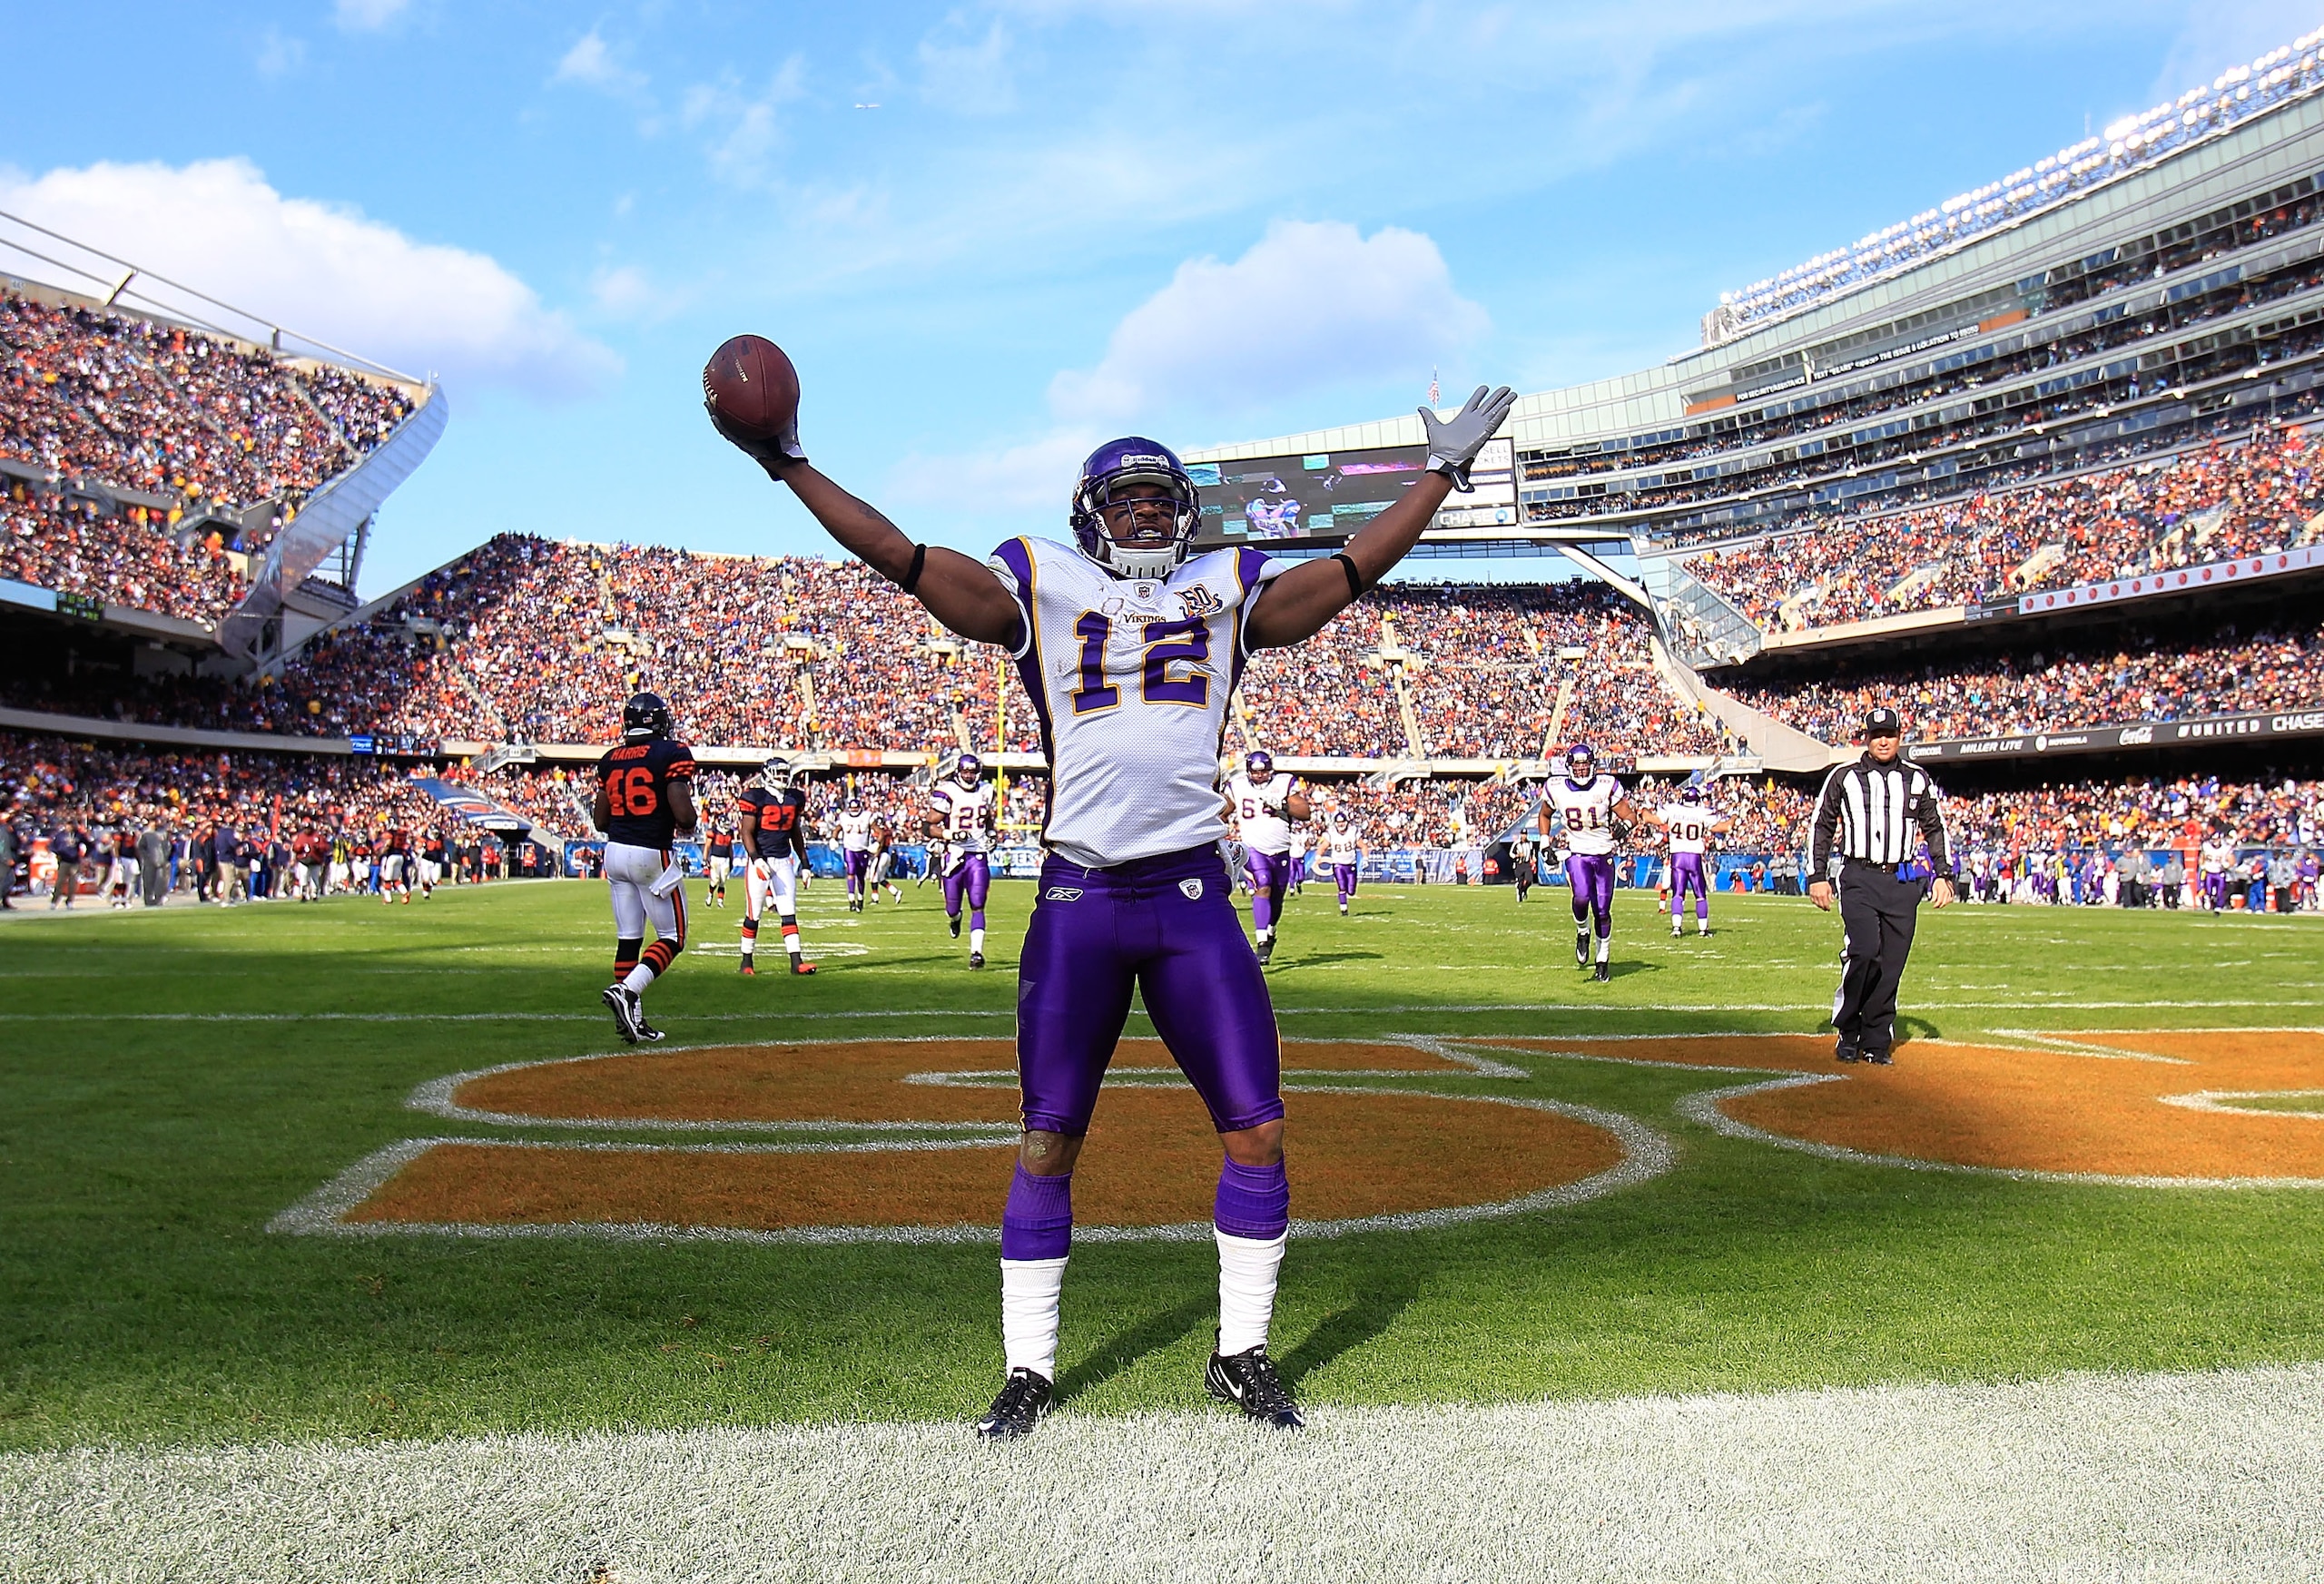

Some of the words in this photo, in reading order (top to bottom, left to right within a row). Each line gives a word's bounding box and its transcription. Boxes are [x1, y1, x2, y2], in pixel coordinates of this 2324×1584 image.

[1916, 333, 1950, 350] LOCATION
[1950, 330, 1959, 340] TO
[1482, 446, 1510, 454] SELL
[1477, 455, 1510, 465] CKETS
[1439, 510, 1492, 525] CHASE
[1071, 608, 1213, 716] 12
[2191, 719, 2260, 737] UNITED
[2271, 713, 2324, 733] CHASE
[1959, 741, 1997, 754] MILLER
[1999, 739, 2024, 752] LITE
[2048, 736, 2088, 746] MOTOROLA
[610, 744, 652, 761] HARRIS
[606, 766, 657, 816] 46
[761, 804, 796, 831] 27
[1565, 806, 1602, 831] 81
[846, 823, 862, 834] 71
[1671, 822, 1699, 841] 40
[1334, 841, 1353, 852] 68
